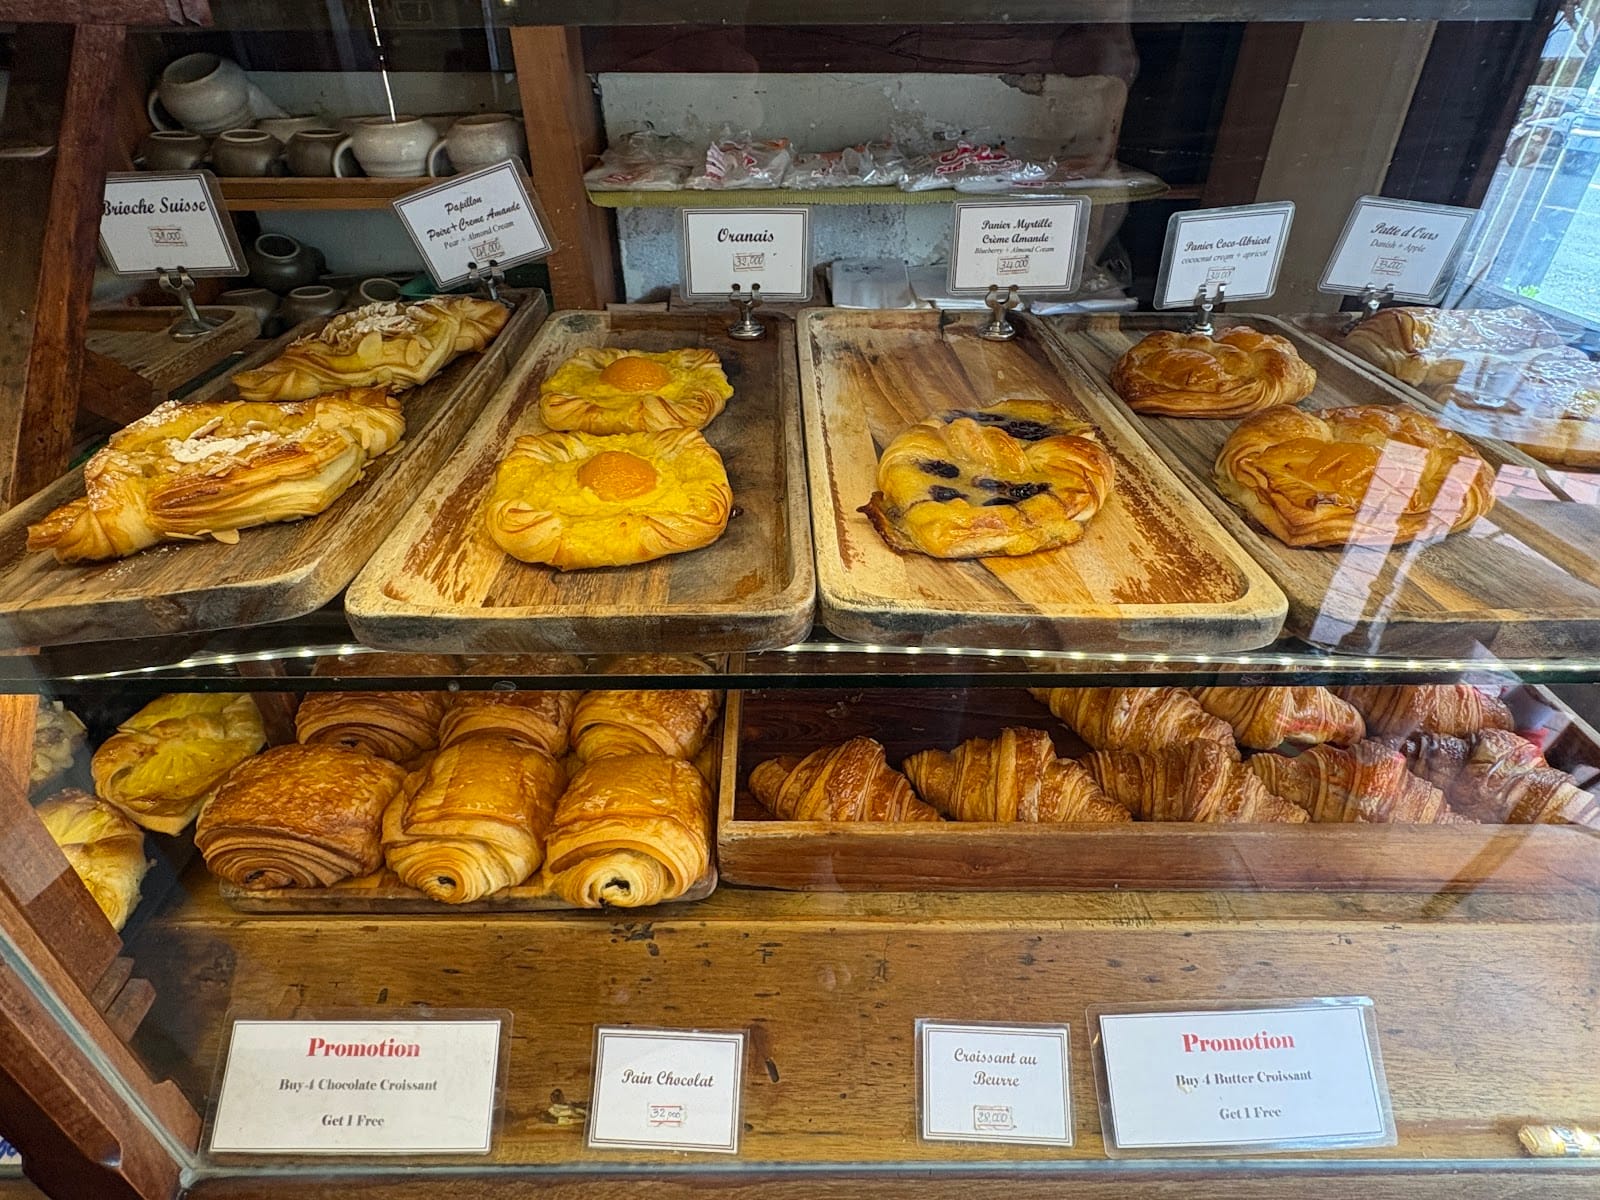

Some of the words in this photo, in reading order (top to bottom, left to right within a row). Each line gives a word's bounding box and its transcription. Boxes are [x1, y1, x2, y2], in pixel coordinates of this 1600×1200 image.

[102, 198, 155, 216] Brioche
[159, 197, 207, 213] Suisse
[444, 195, 483, 215] Papillon
[486, 201, 521, 220] Amande
[981, 220, 1011, 230] Panier
[1013, 218, 1053, 231] Myrtille
[1370, 222, 1401, 236] Patte
[717, 228, 774, 242] Oranais
[982, 233, 1010, 244] Crème
[1011, 232, 1049, 243] Amande
[1184, 241, 1214, 252] Panier
[1216, 236, 1272, 249] Coco-Abricot
[306, 1037, 421, 1058] Promotion
[1182, 1030, 1295, 1053] Promotion
[954, 1047, 1016, 1065] Croissant
[1019, 1055, 1038, 1066] au
[279, 1078, 303, 1093] Buy
[305, 1078, 315, 1091] 4
[318, 1078, 377, 1091] Chocolate
[380, 1078, 438, 1091] Croissant
[621, 1068, 653, 1085] Pain
[656, 1070, 715, 1088] Chocolat
[972, 1071, 1020, 1087] Beurre
[1176, 1074, 1199, 1088] Buy
[1202, 1073, 1211, 1086] 4
[1214, 1073, 1254, 1085] Butter
[1257, 1070, 1312, 1083] Croissant
[322, 1114, 344, 1127] Get
[356, 1114, 385, 1127] Free
[1219, 1107, 1242, 1120] Get
[1244, 1107, 1251, 1119] 1
[1254, 1106, 1282, 1119] Free
